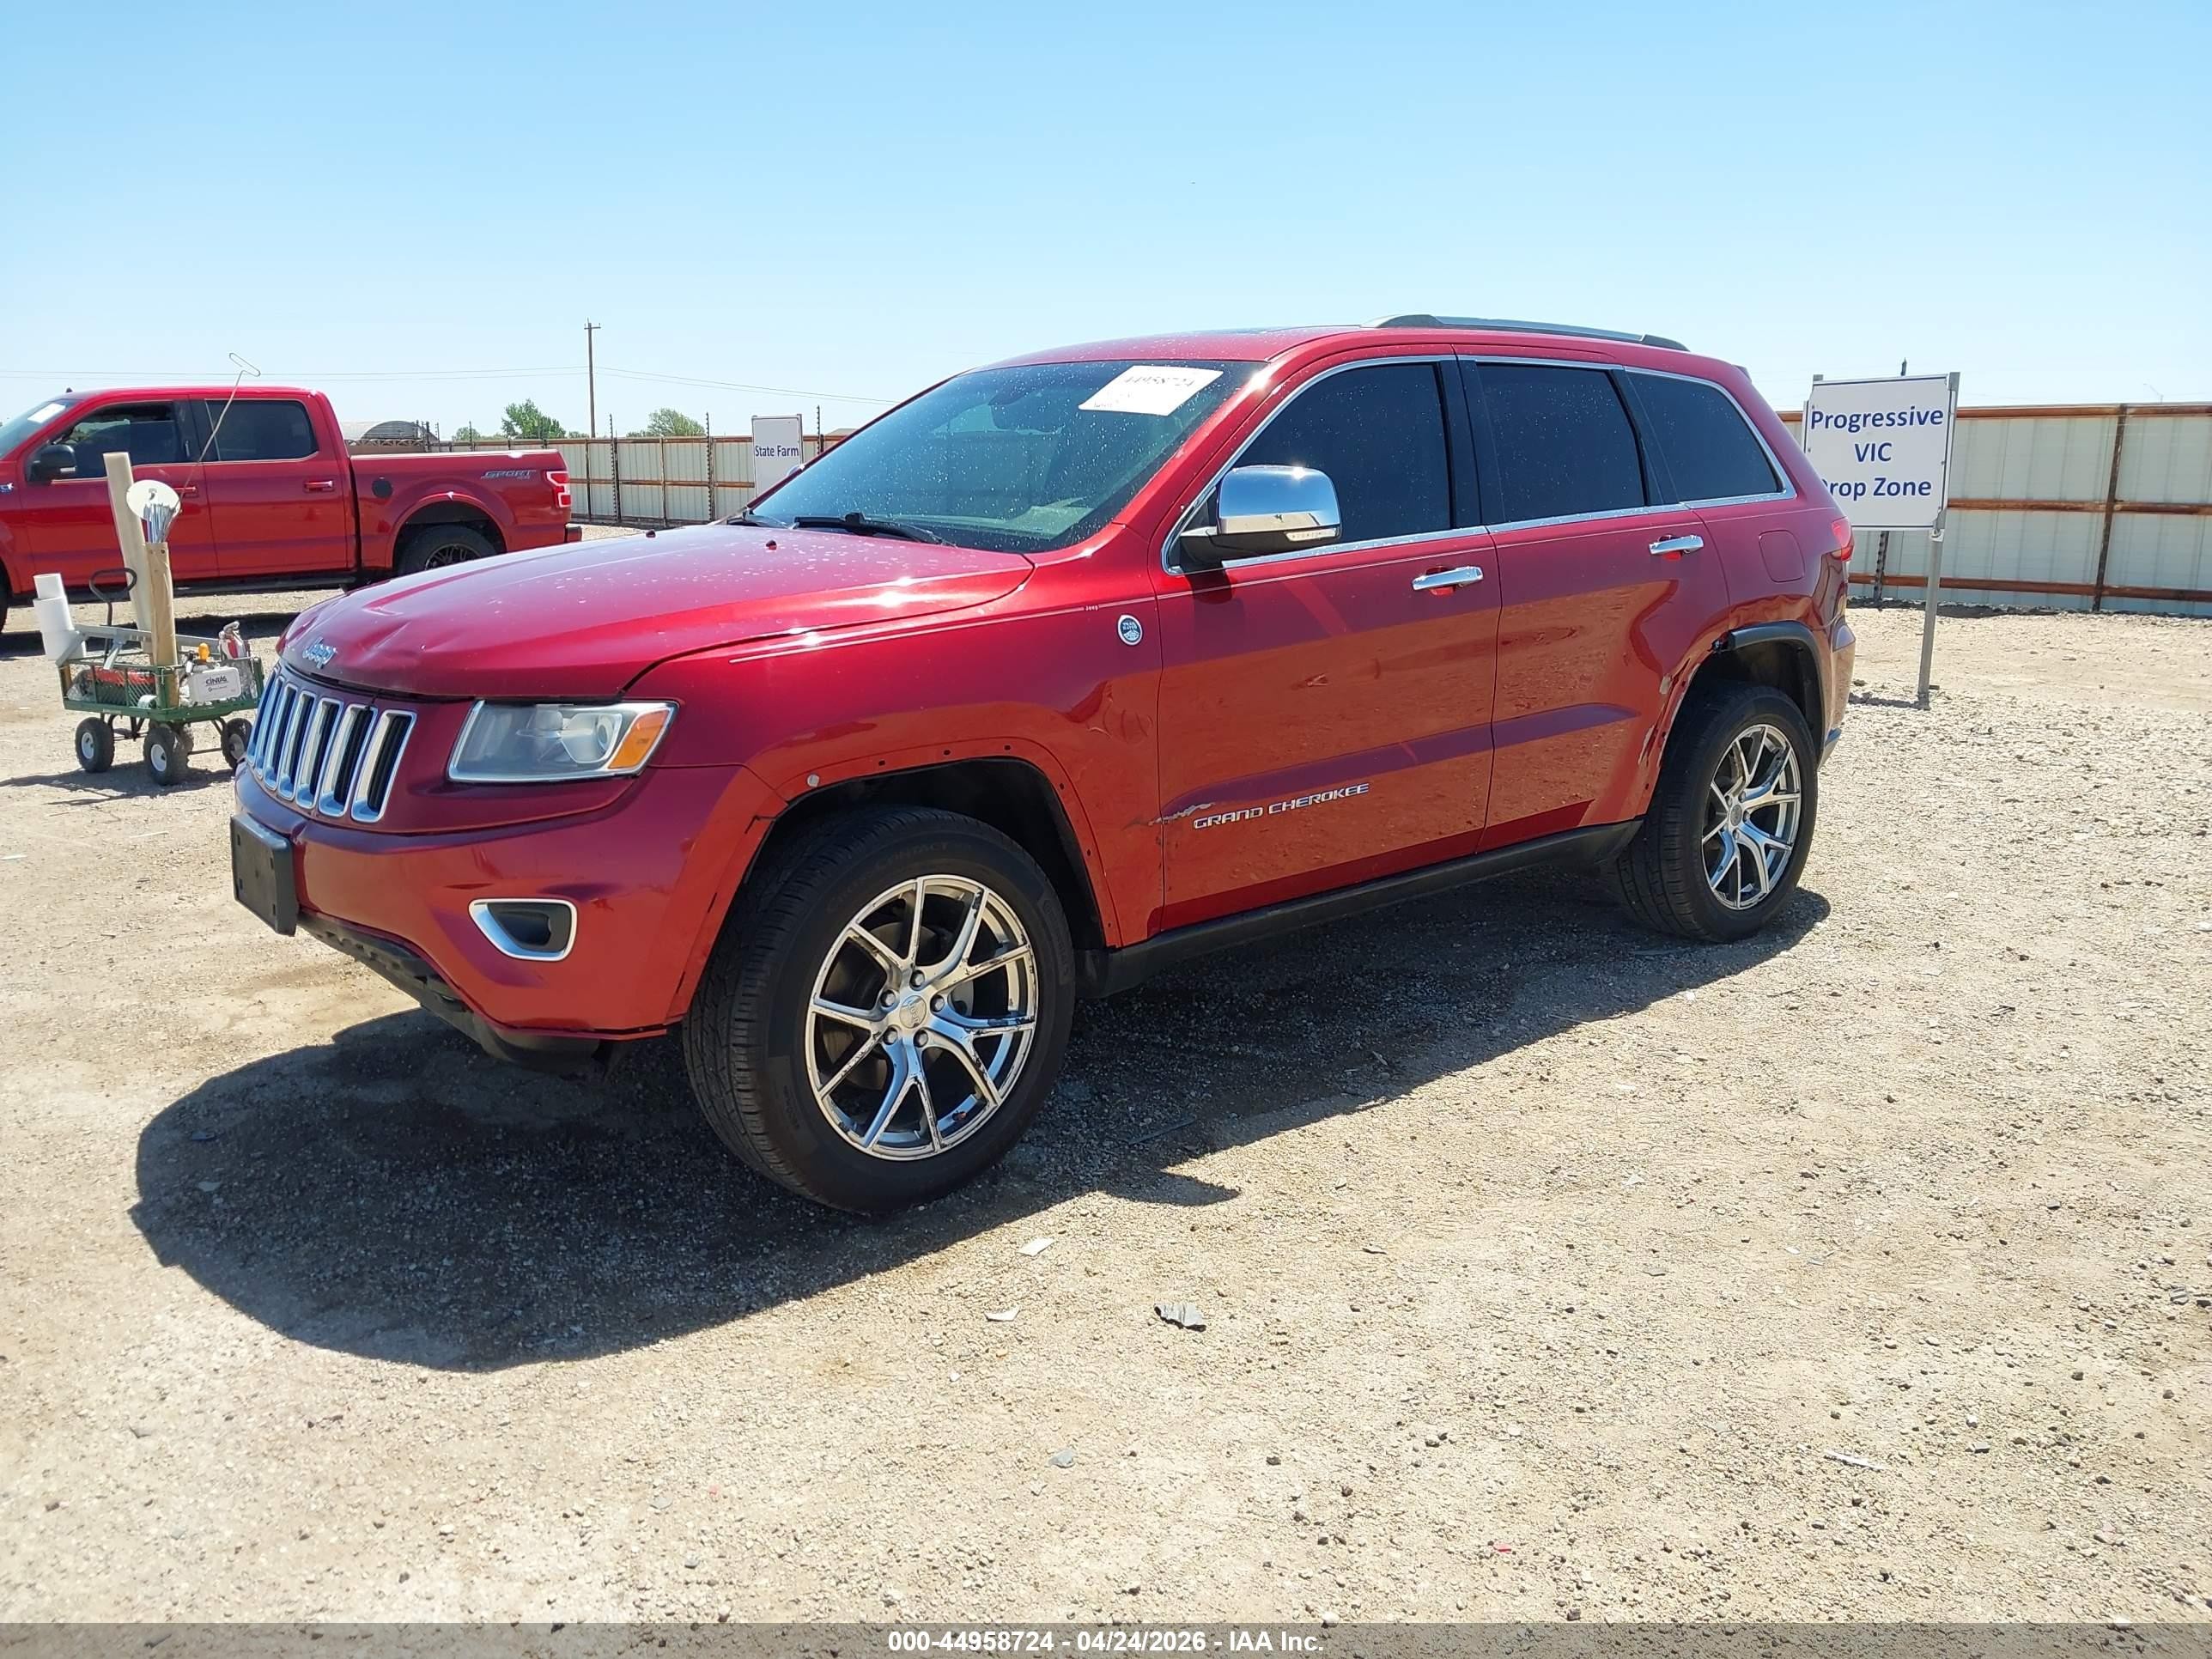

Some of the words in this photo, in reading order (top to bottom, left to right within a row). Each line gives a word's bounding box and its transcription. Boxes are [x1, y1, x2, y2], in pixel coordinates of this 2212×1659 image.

[1811, 405, 1943, 434] Progressive
[755, 446, 775, 458] State
[777, 445, 799, 457] Farm
[1854, 441, 1893, 463] VIC
[1872, 477, 1932, 496] Zone
[1193, 806, 1263, 830] GRAND
[1267, 782, 1370, 815] CHEROKEE
